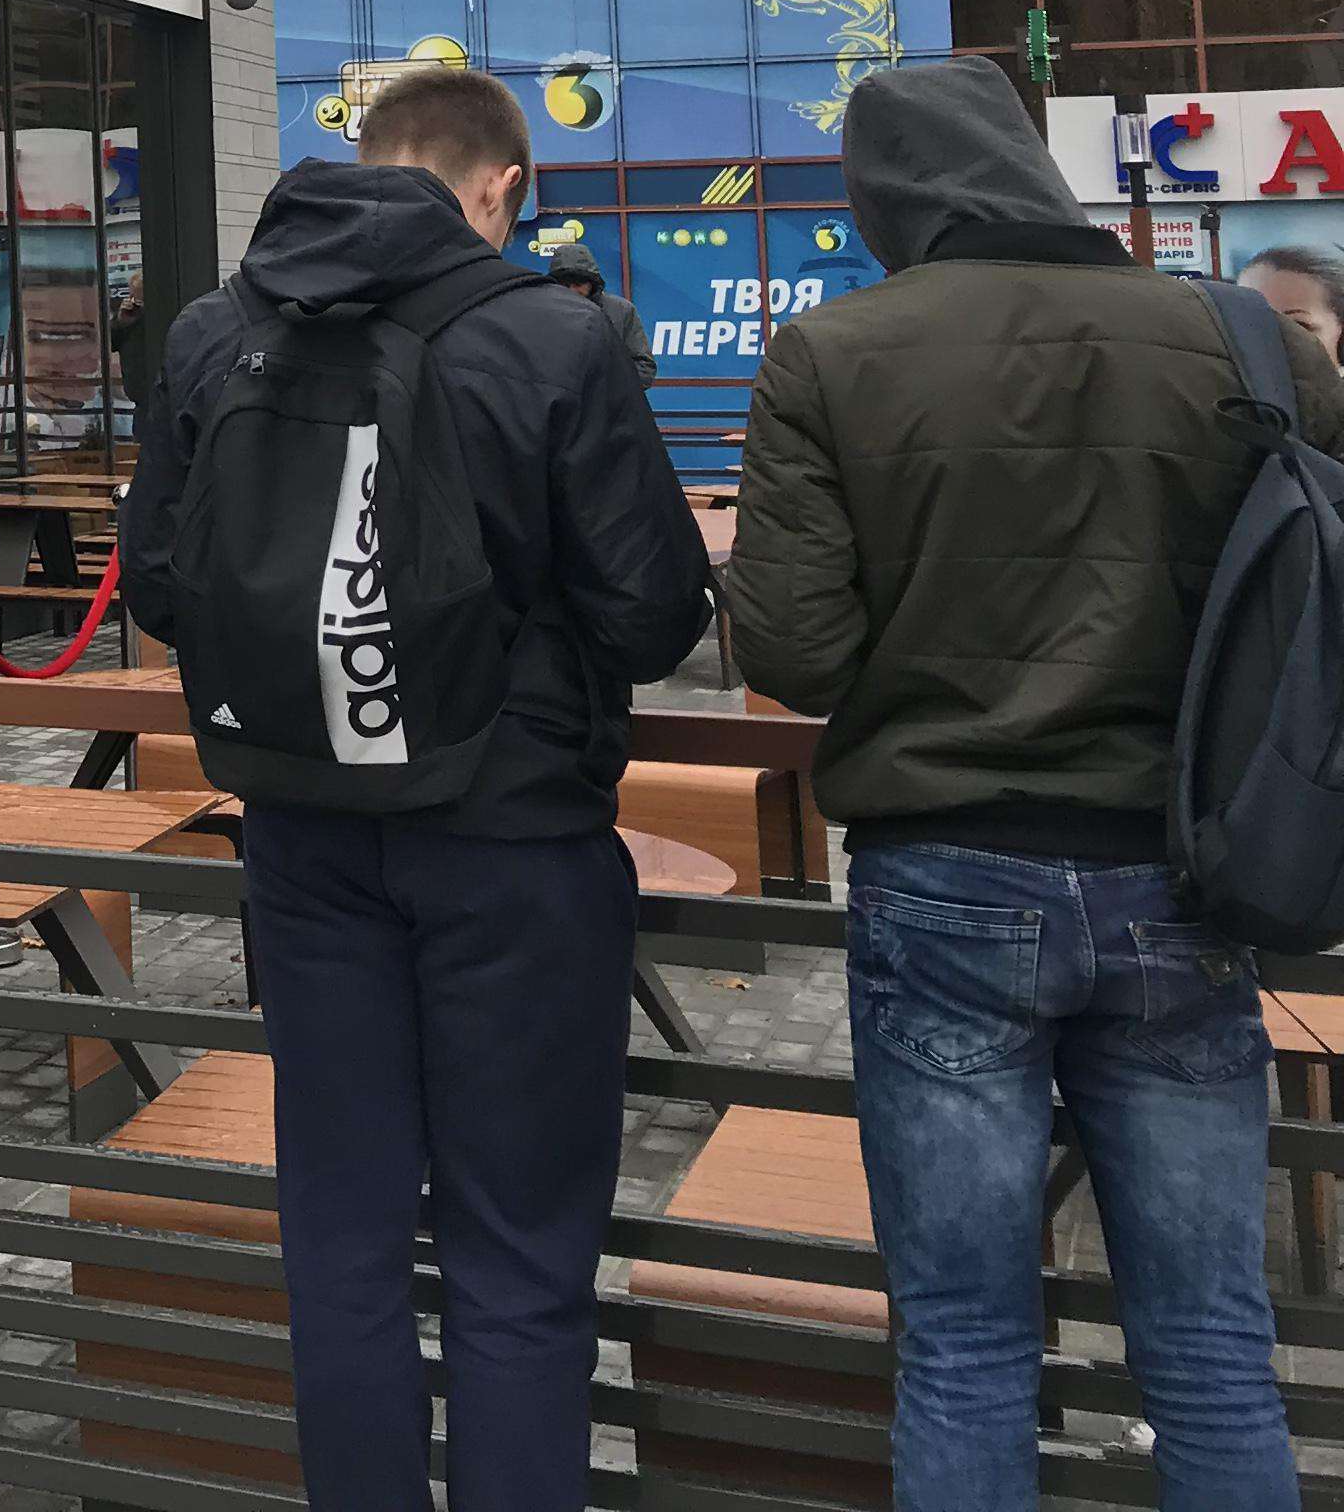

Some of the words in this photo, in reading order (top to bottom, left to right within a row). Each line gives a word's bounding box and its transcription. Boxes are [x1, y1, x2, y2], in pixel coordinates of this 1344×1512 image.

[1117, 183, 1221, 194] МД-СЕРВІС
[710, 278, 824, 314] ТВОЯ
[210, 714, 242, 729] adidas
